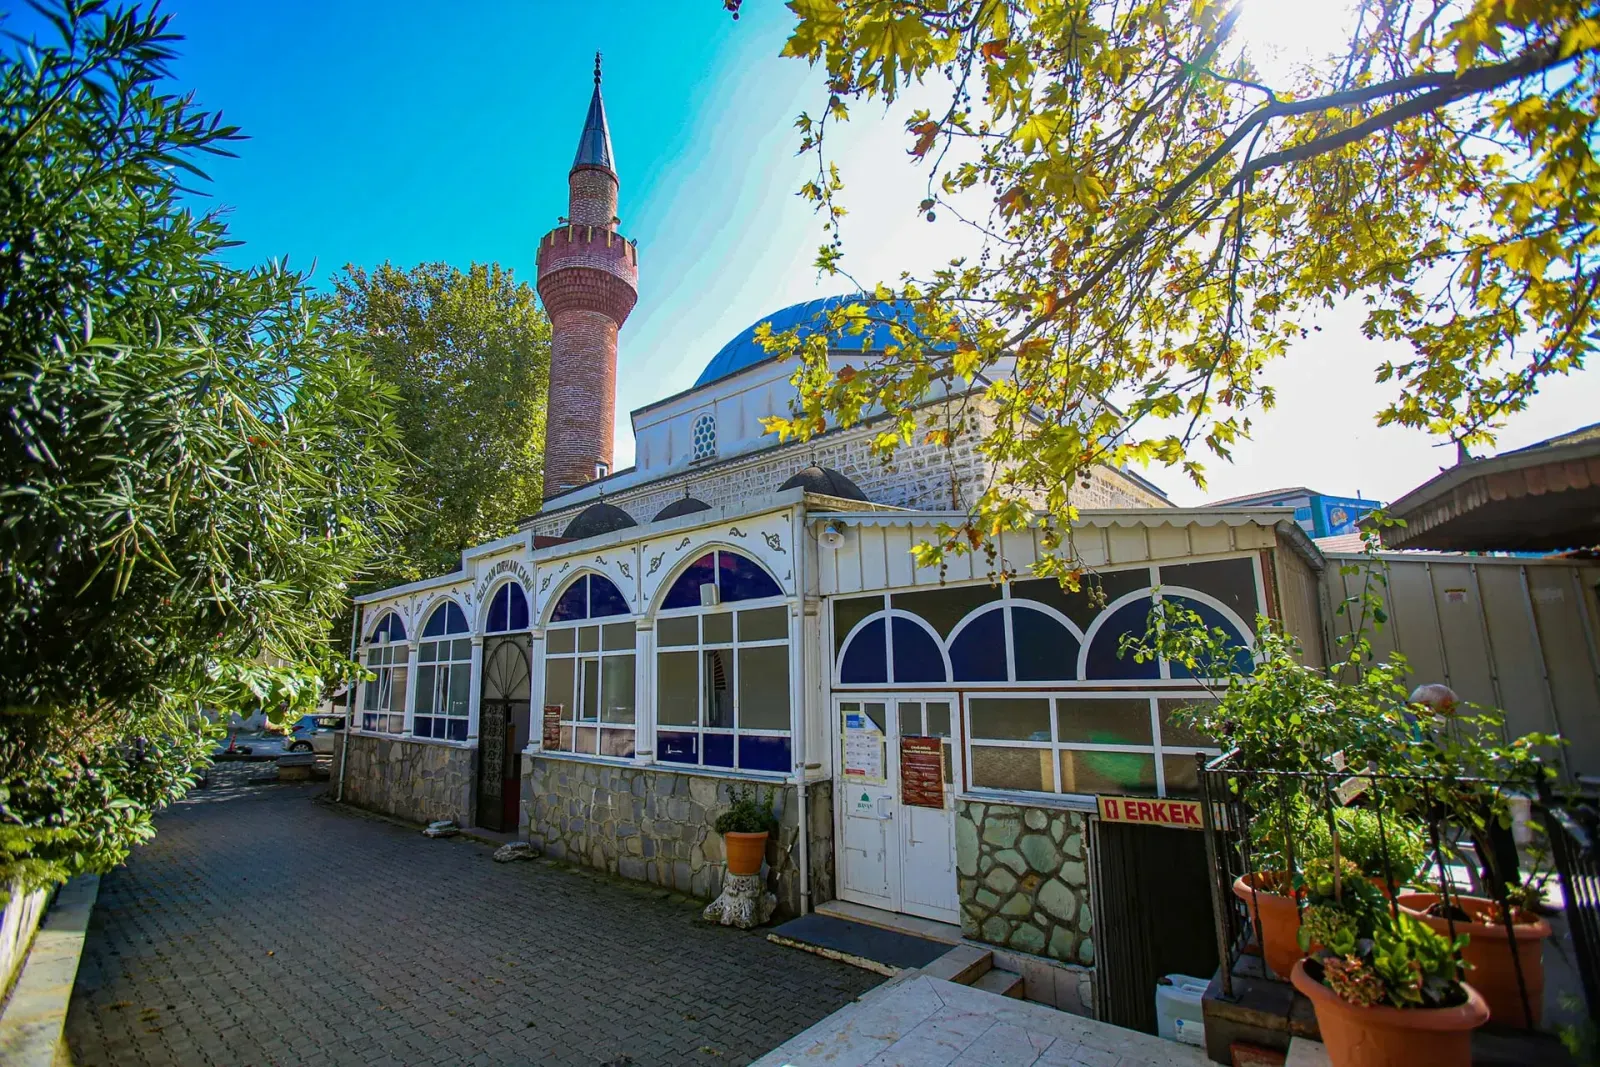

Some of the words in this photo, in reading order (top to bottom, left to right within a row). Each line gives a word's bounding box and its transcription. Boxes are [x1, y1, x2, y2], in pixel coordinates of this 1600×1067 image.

[476, 566, 497, 604] SULTAN
[496, 559, 519, 575] ORHAN
[1123, 800, 1201, 825] ERKEK
